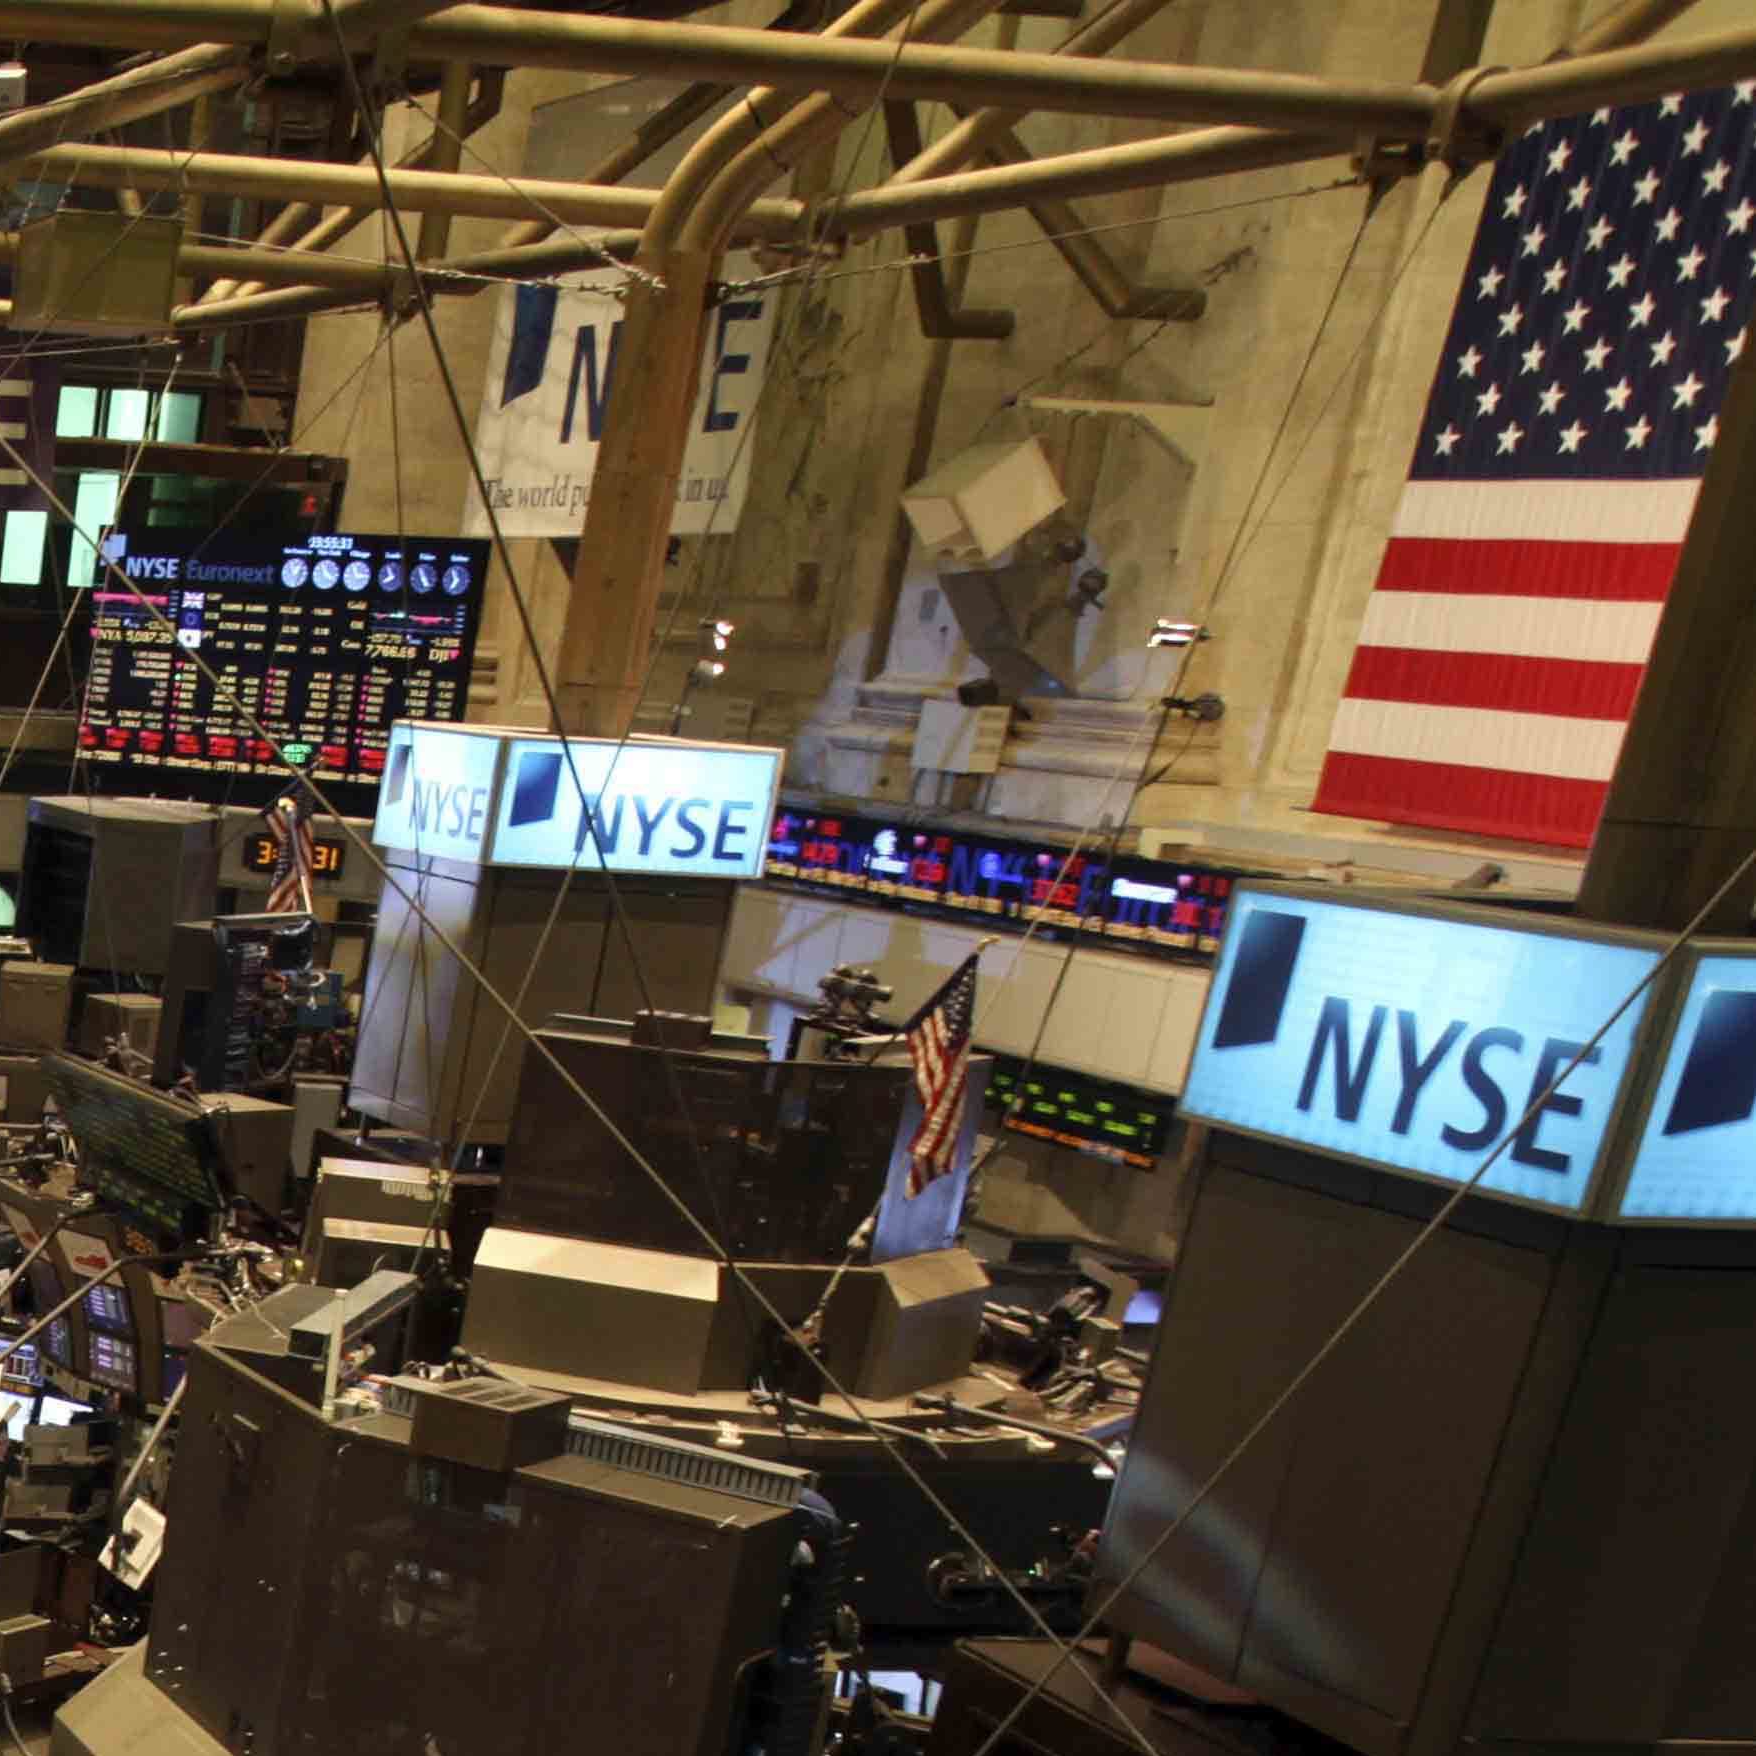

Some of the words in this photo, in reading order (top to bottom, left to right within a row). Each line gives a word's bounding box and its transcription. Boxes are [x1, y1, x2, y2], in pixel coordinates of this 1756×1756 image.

[559, 301, 764, 443] NE
[484, 480, 513, 509] The
[519, 474, 569, 509] world
[125, 557, 180, 579] NYSE
[185, 561, 275, 585] Euronext
[409, 778, 485, 842] NYSE
[573, 791, 756, 863] NYSE
[1295, 996, 1601, 1174] NYSE
